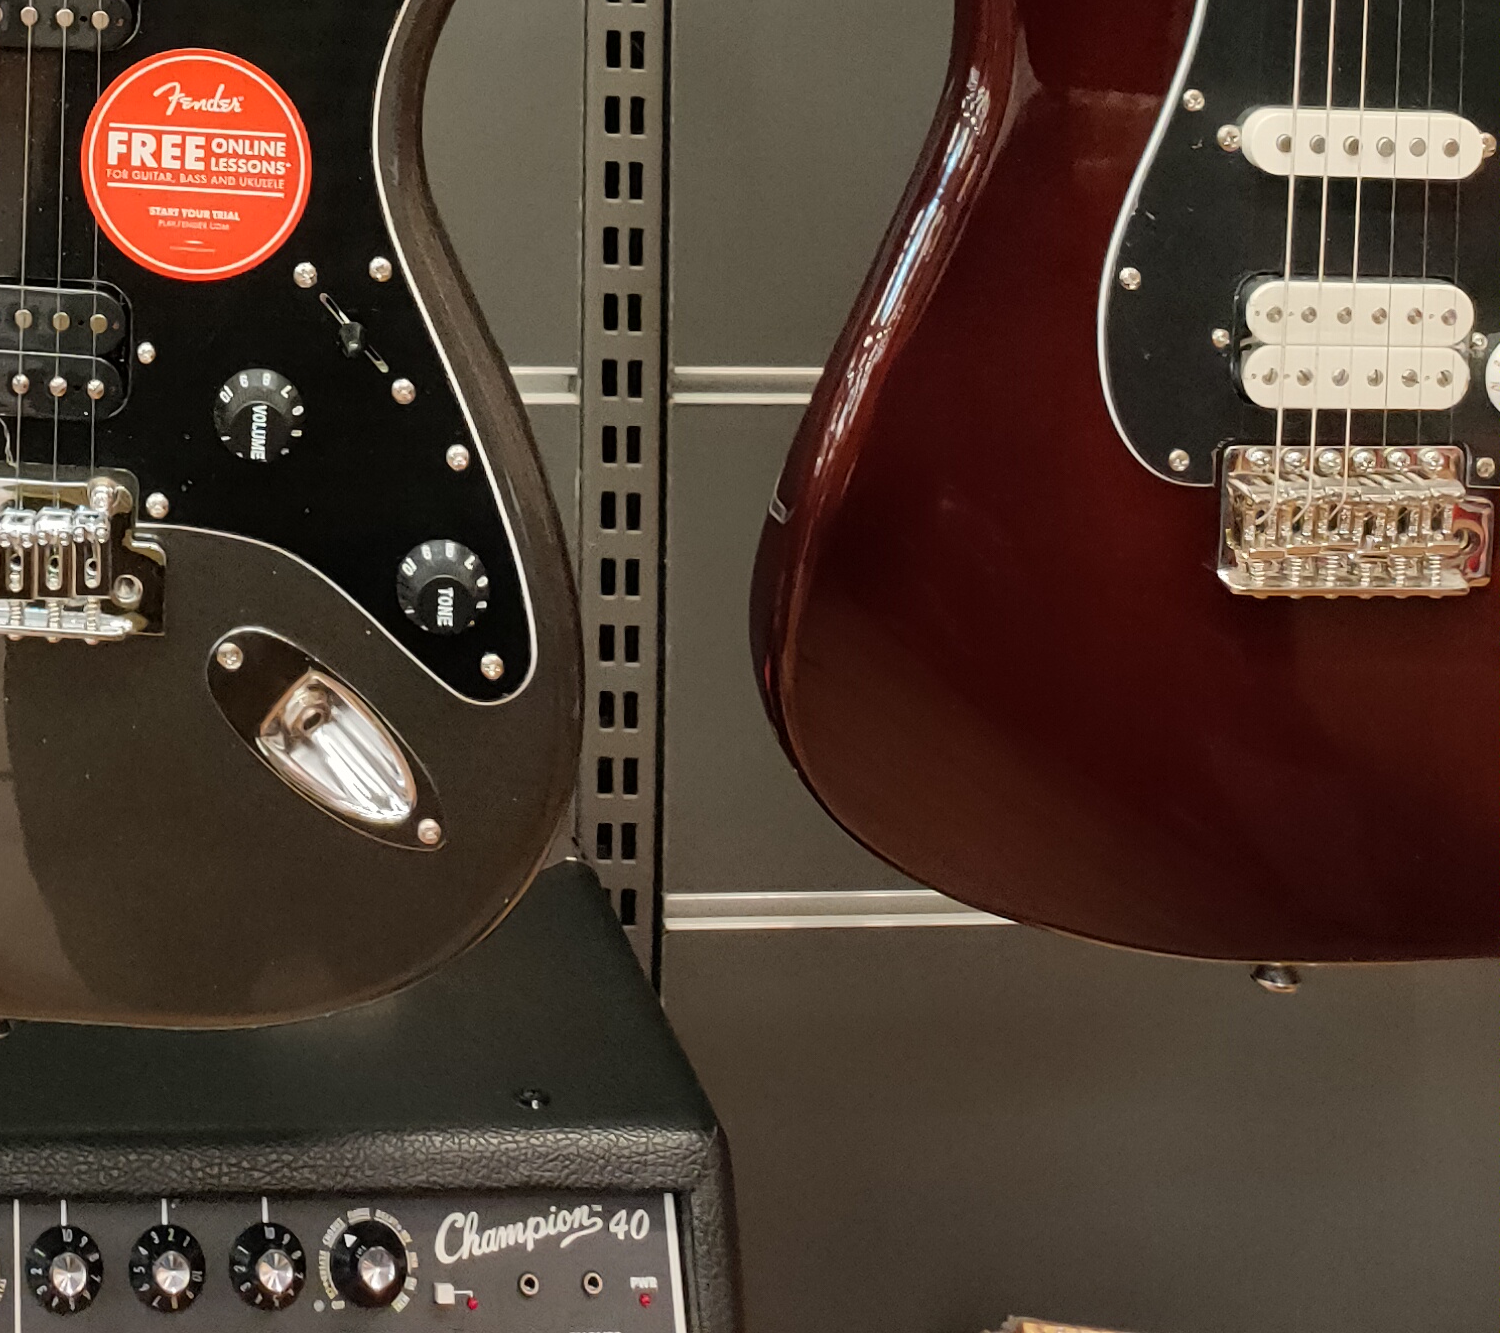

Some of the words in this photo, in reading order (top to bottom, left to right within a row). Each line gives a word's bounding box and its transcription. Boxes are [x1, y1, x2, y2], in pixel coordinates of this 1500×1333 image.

[153, 82, 243, 116] Fender
[107, 131, 206, 171] FREE
[211, 137, 287, 158] ONLINE
[106, 168, 129, 180] FOR
[179, 172, 208, 184] BASS
[210, 174, 236, 186] AND
[239, 177, 285, 190] UKULELE
[149, 206, 179, 217] START
[181, 208, 211, 220] YOUR
[212, 210, 240, 221] TRIAL
[250, 405, 268, 460] VOLUME
[437, 586, 454, 627] TONE
[434, 1204, 604, 1265] Champion
[608, 1208, 650, 1240] 40
